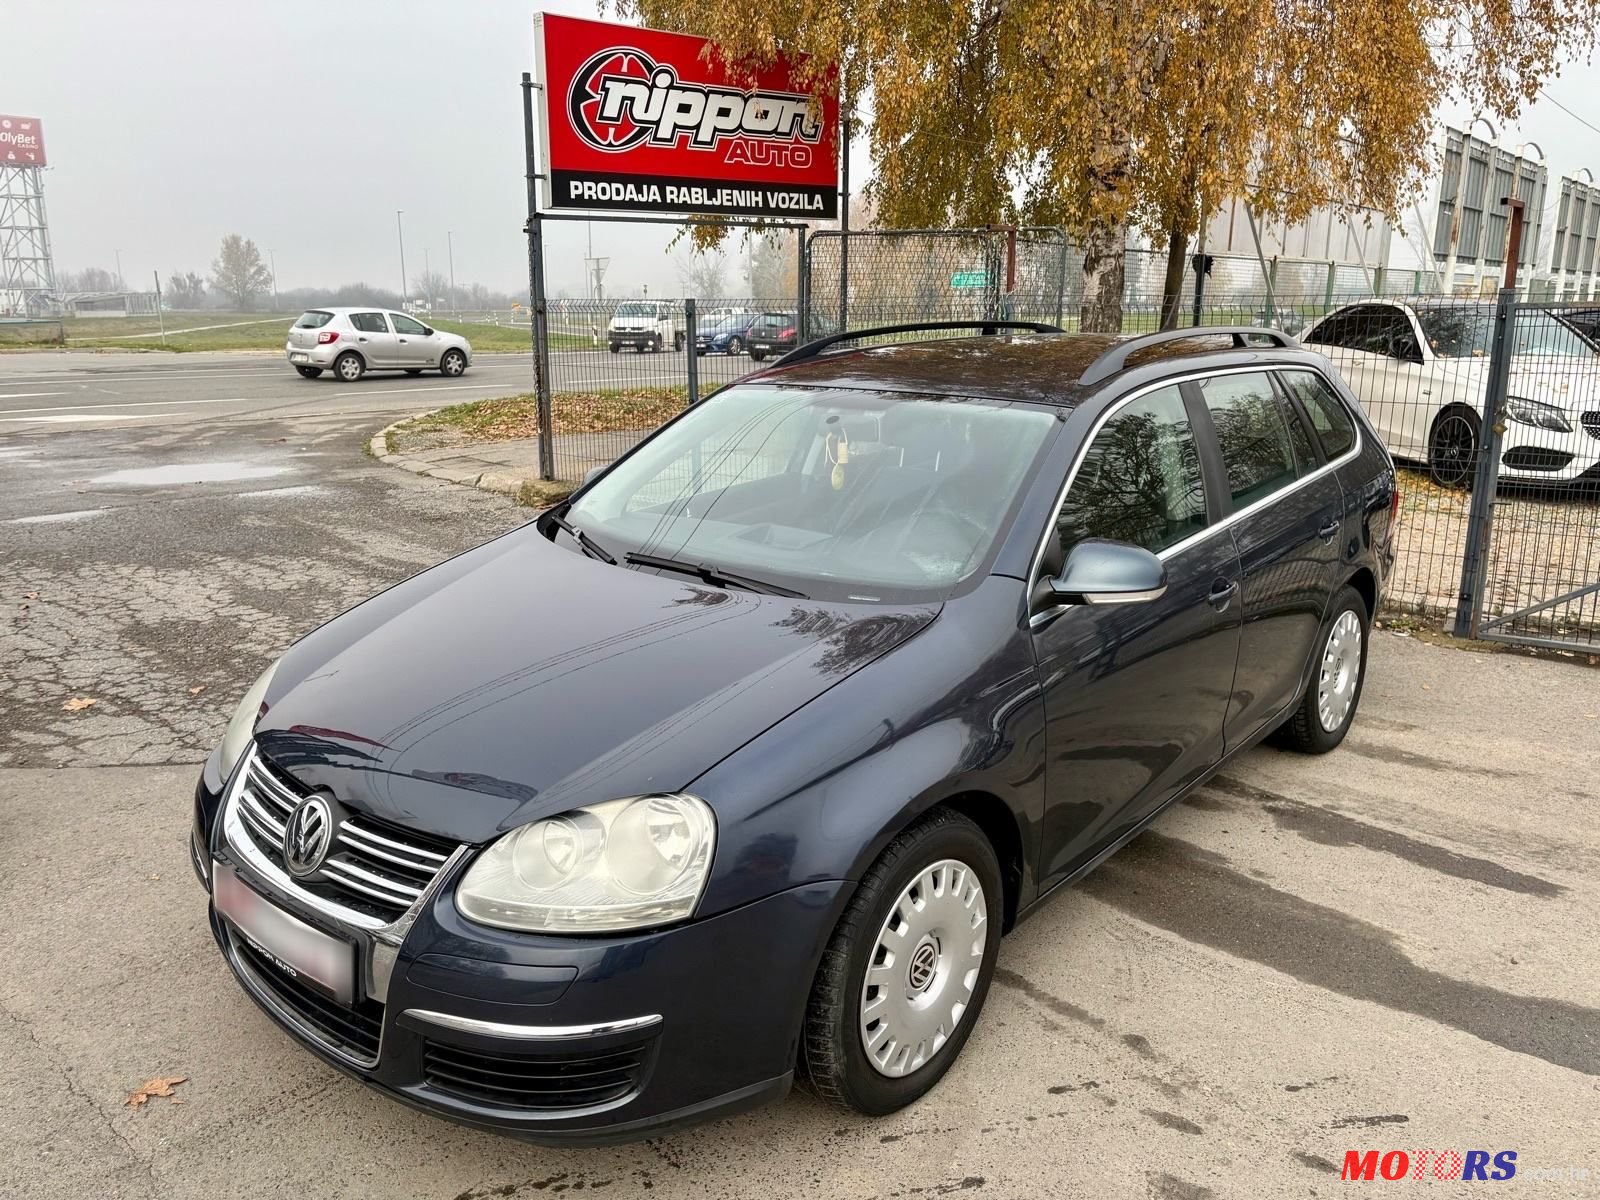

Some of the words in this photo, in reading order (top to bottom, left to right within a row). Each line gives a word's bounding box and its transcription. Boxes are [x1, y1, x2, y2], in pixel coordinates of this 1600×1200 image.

[599, 67, 821, 146] nippon
[0, 132, 36, 145] OlyBet
[725, 140, 812, 168] AUTO
[570, 180, 661, 204] PRODAJA
[666, 185, 764, 209] RABLJENIH
[766, 191, 824, 211] VOZILA
[275, 959, 297, 977] AUTO
